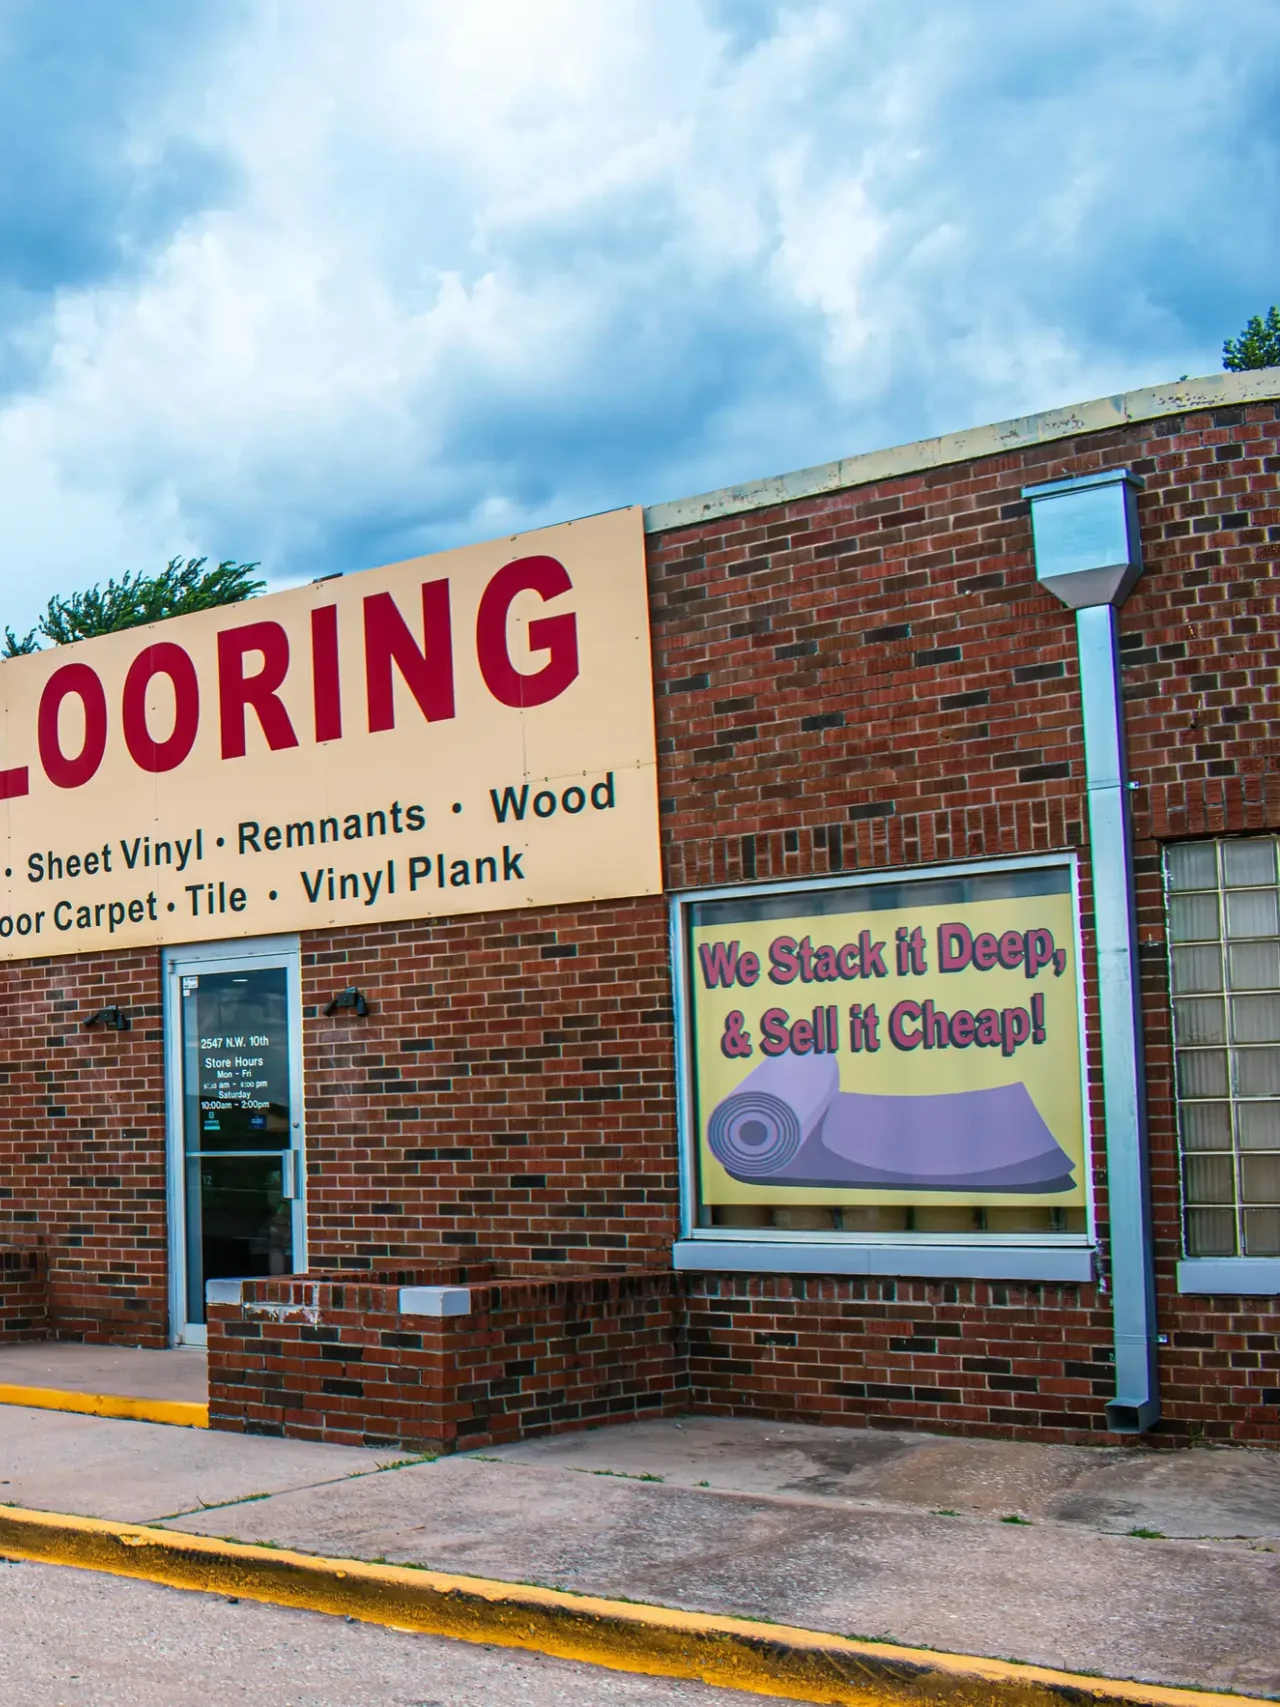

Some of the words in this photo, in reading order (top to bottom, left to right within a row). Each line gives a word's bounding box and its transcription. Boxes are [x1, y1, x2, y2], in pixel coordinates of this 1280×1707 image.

[27, 843, 112, 883] Sheet
[120, 828, 203, 872] Vinyl
[238, 800, 426, 855] Remnants
[489, 771, 616, 823] Wood
[54, 891, 158, 933] Carpet
[185, 881, 247, 916] Tile
[300, 859, 395, 906] Vinyl
[409, 845, 525, 892] Plank
[698, 940, 760, 989] We
[768, 929, 887, 985] Stack
[895, 926, 928, 977] it
[937, 922, 1067, 979] Deep,
[720, 1010, 753, 1059] &
[759, 1005, 839, 1057] Sell
[849, 1003, 881, 1053] it
[888, 992, 1046, 1057] Cheap!
[200, 1038, 224, 1049] 2547
[225, 1036, 247, 1048] N.W.
[249, 1035, 270, 1047] 10th
[205, 1057, 232, 1069] Store
[235, 1056, 264, 1067] Hours
[217, 1070, 233, 1079] Mon
[241, 1069, 252, 1078] Fri
[218, 1081, 231, 1089] am
[255, 1080, 268, 1089] pm
[218, 1090, 251, 1099] Saturday
[200, 1101, 233, 1110] 10:00am
[241, 1100, 270, 1110] 2:00pm
